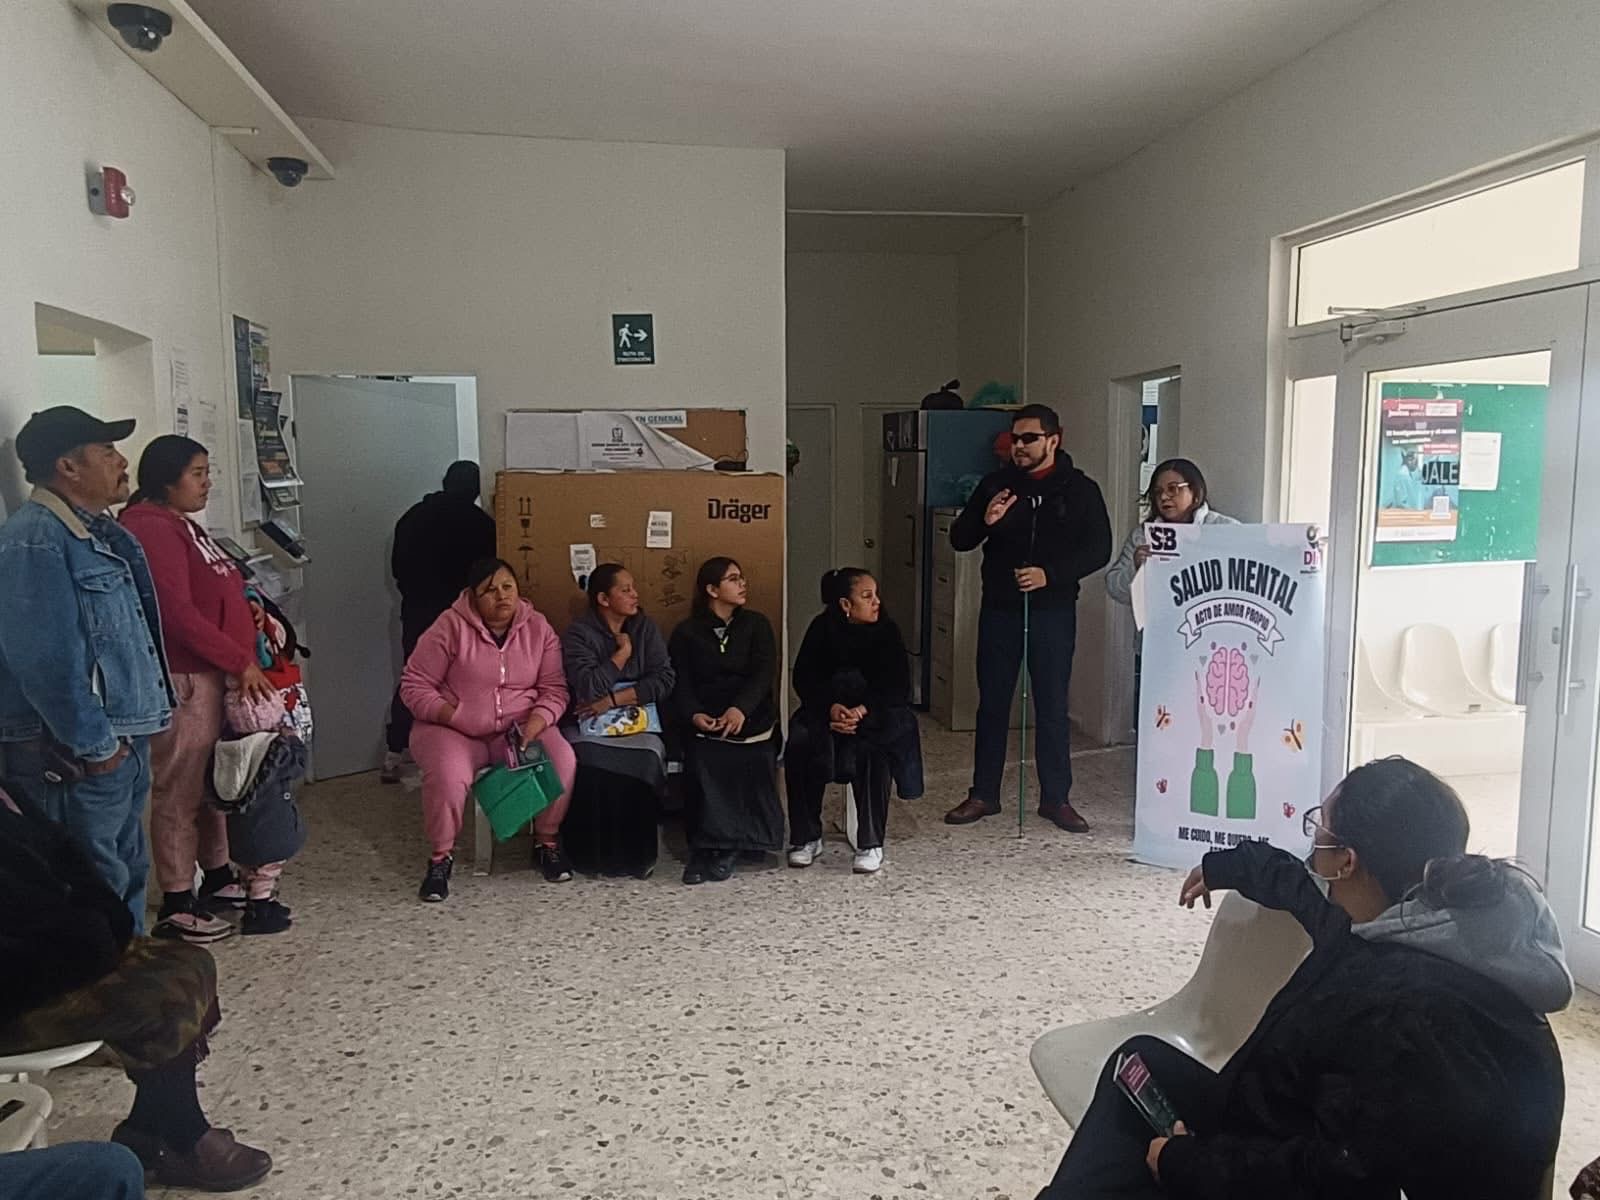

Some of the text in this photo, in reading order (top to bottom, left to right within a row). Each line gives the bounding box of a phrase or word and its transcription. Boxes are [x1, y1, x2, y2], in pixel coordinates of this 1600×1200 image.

[708, 498, 771, 523] Dräger
[1170, 557, 1298, 616] SALUD MENTAL
[1195, 602, 1270, 632] ACTO DE AMOR PROPIO
[1178, 826, 1189, 840] ME
[1214, 831, 1226, 845] ME
